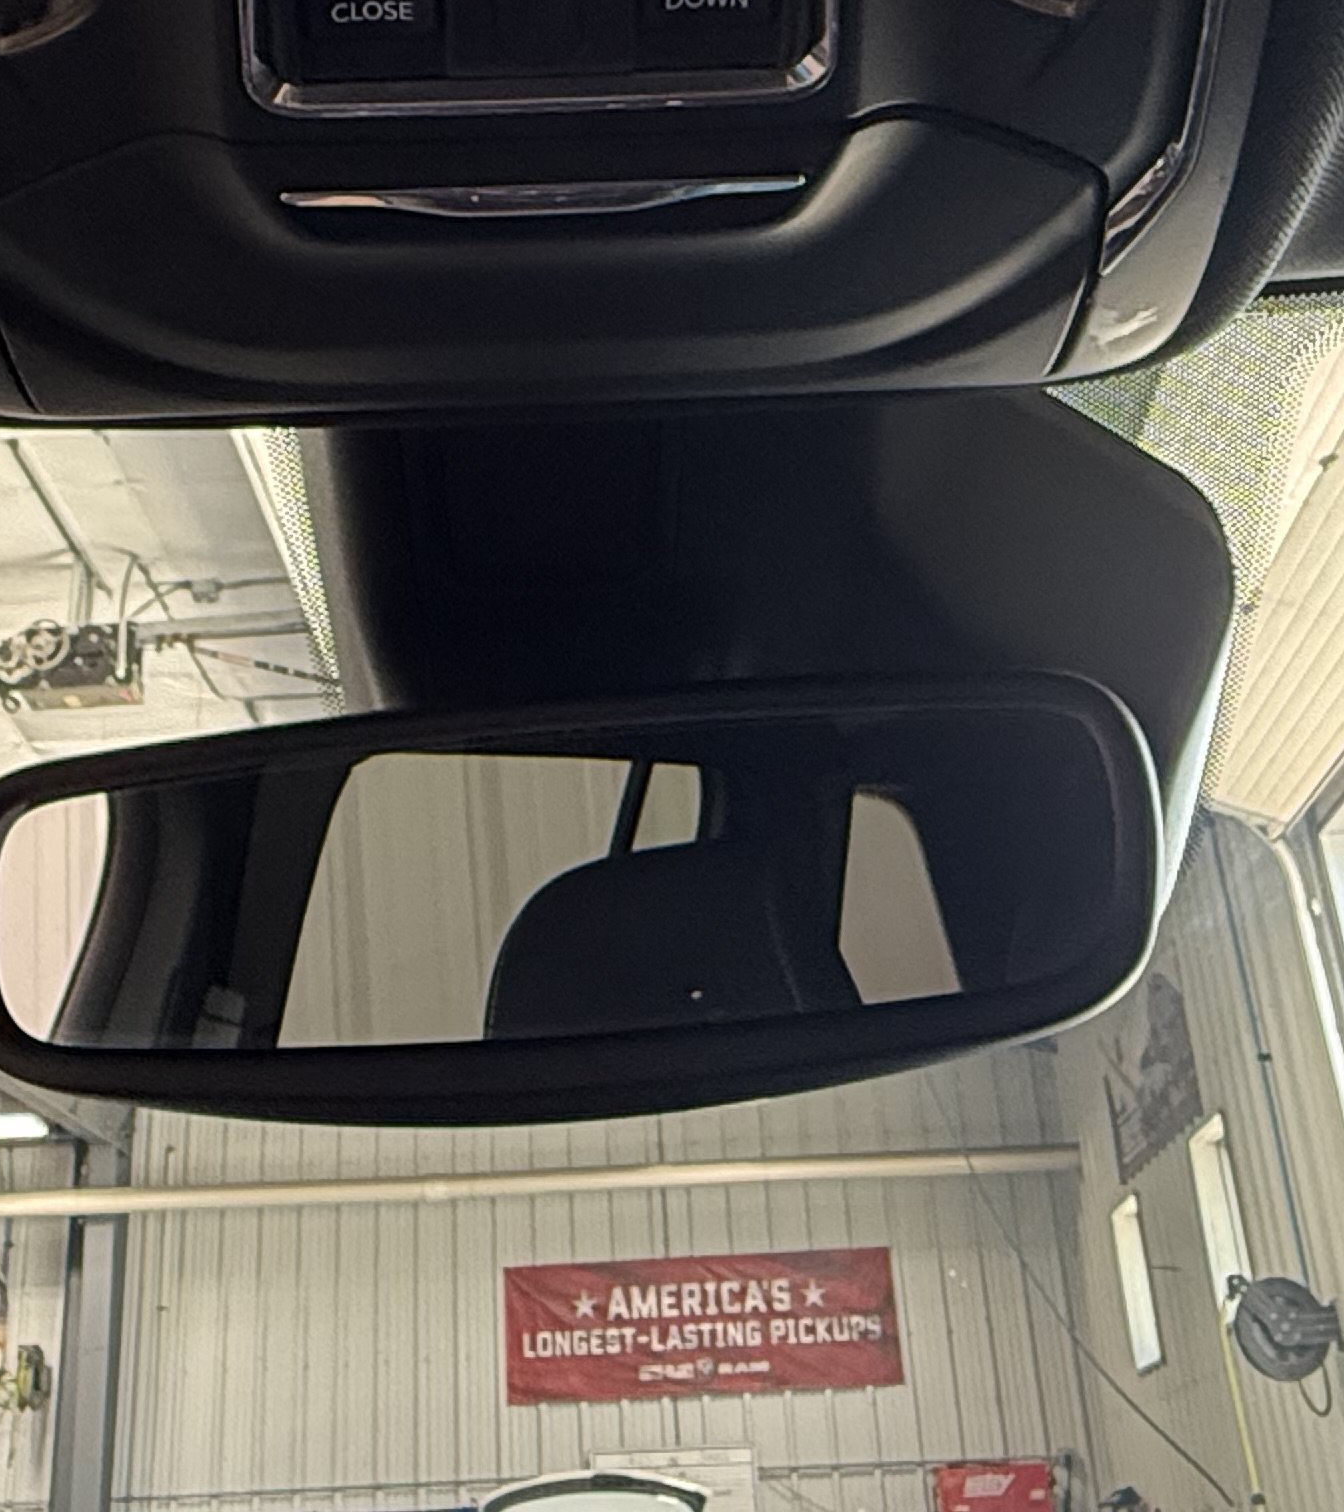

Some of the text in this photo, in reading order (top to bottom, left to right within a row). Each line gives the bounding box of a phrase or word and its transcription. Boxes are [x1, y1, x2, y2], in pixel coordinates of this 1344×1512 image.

[331, 0, 414, 23] CLOSE
[607, 1277, 792, 1322] AMERICA'S
[522, 1314, 882, 1359] LONGEST-LASTING PICKUPS
